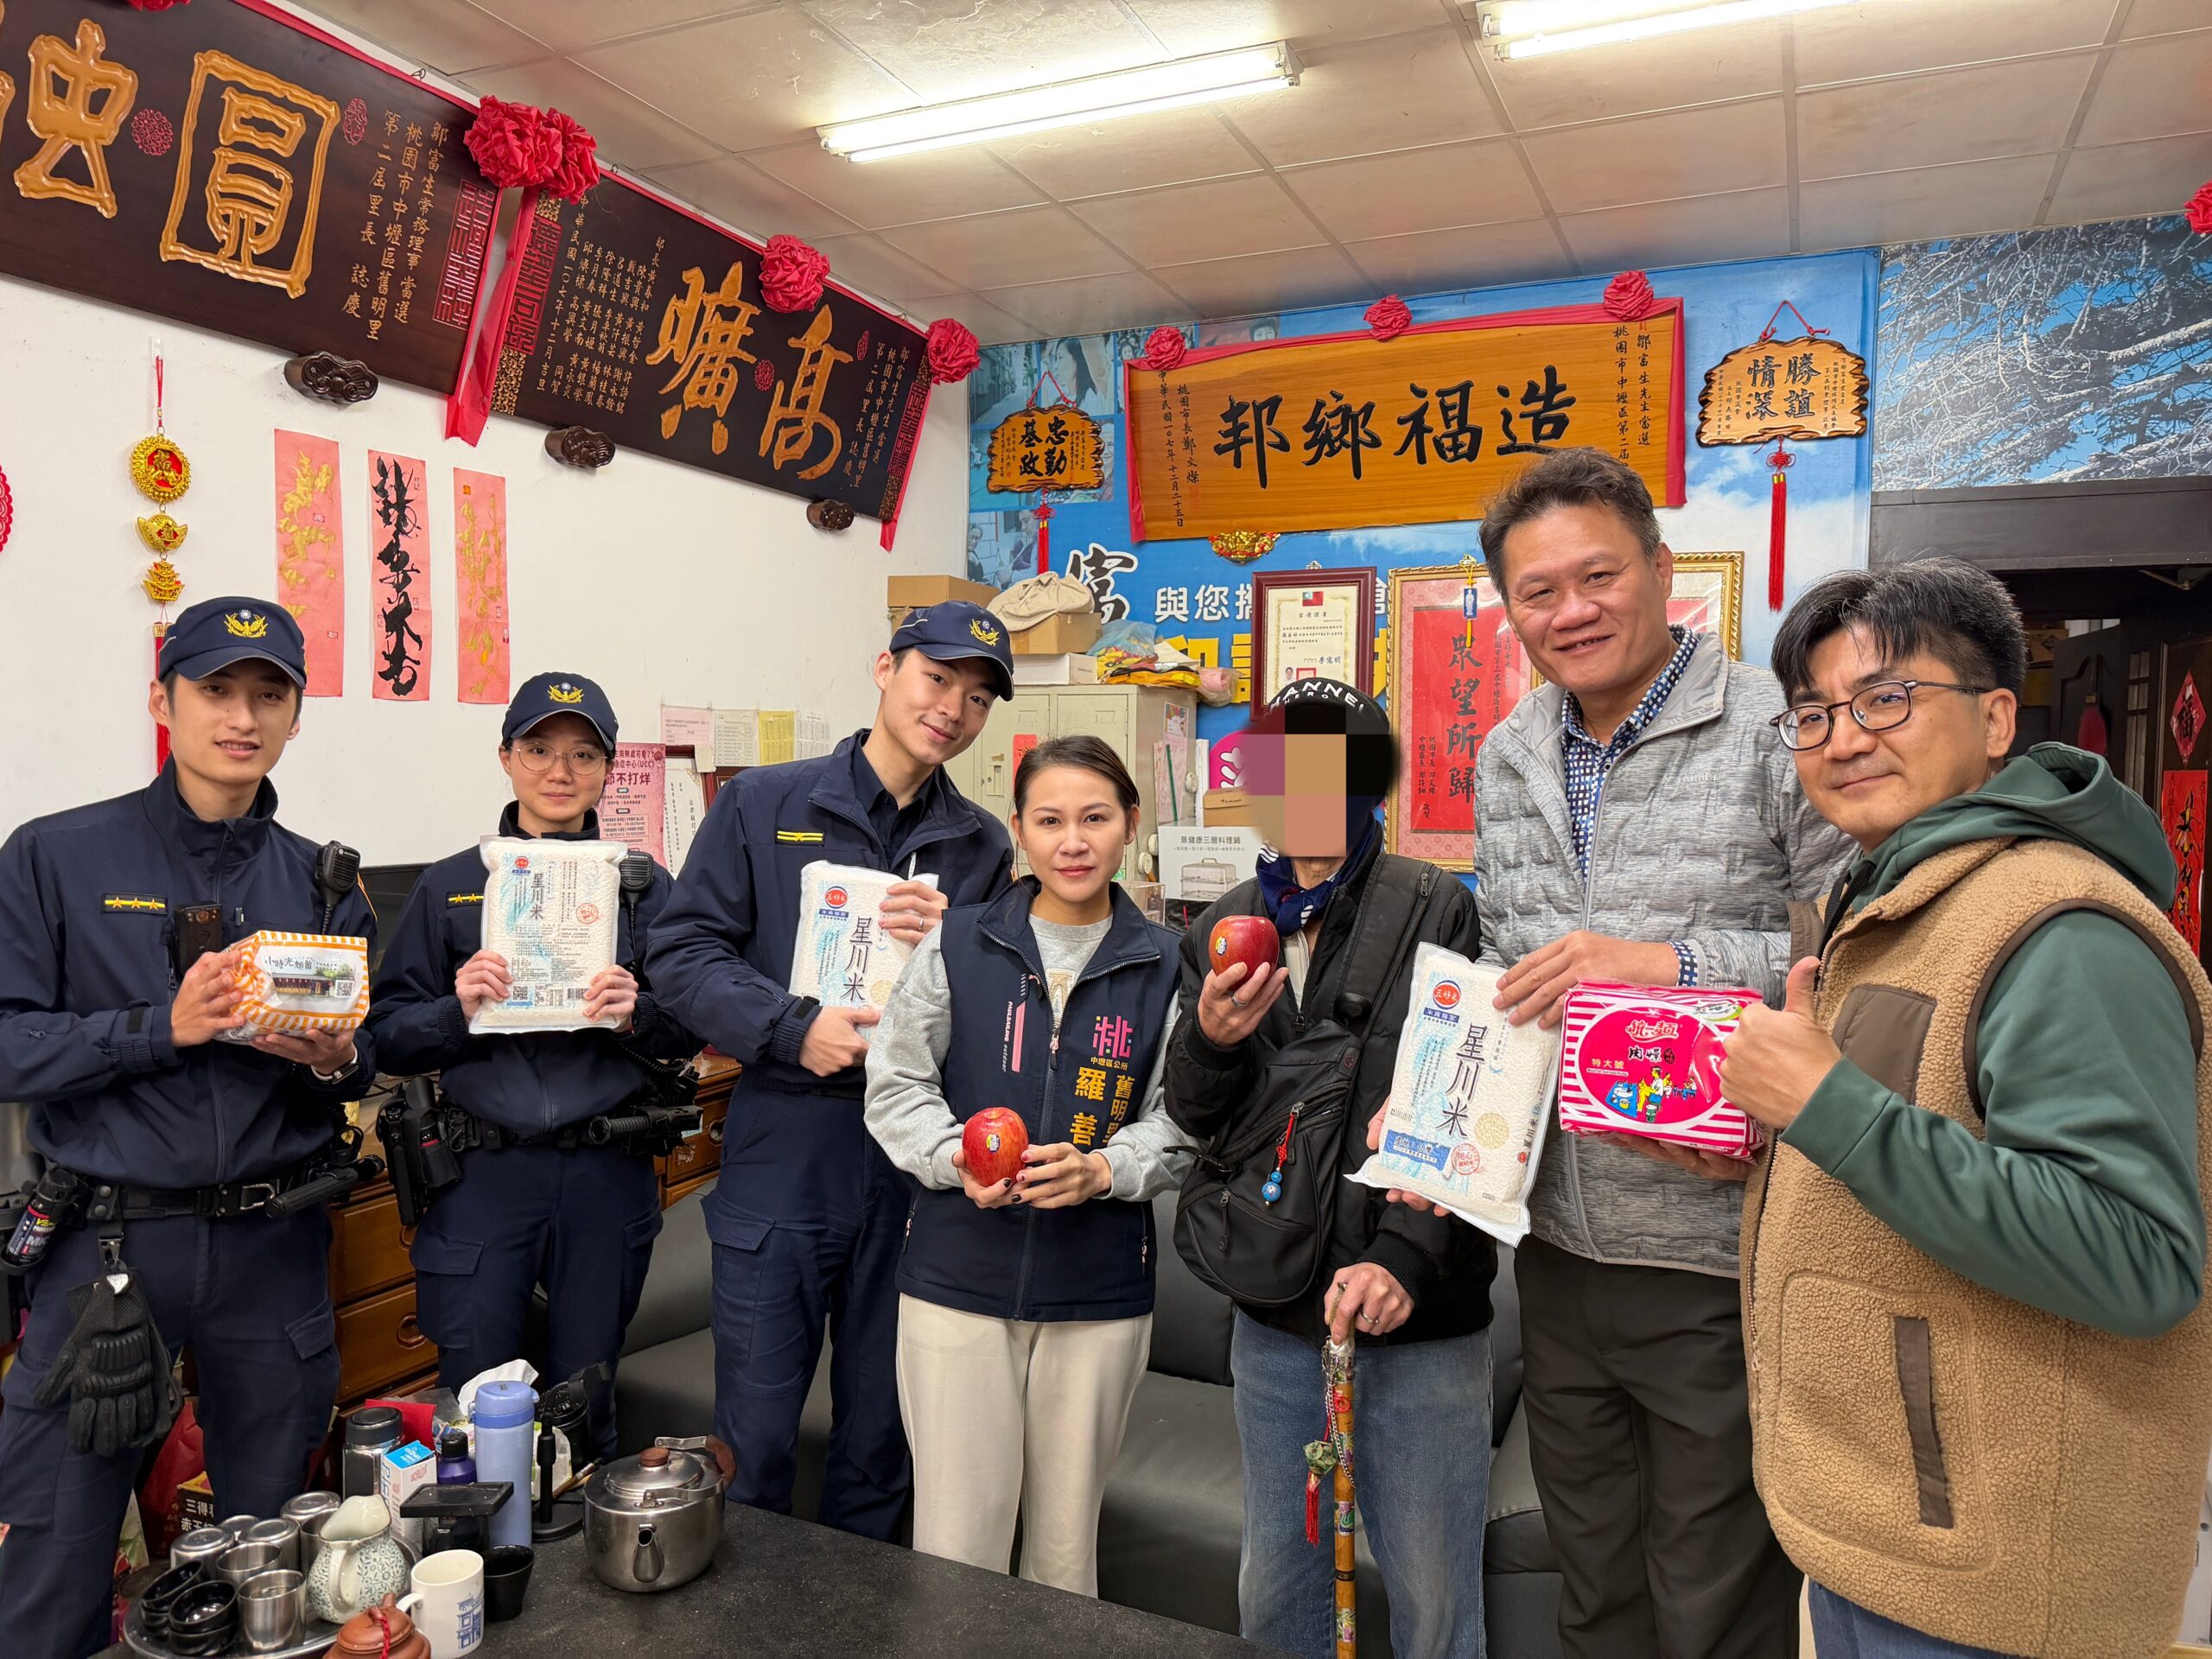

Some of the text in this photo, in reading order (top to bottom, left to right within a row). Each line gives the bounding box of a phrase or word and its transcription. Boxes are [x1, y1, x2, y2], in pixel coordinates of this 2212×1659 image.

[366, 122, 423, 340] 桃園市中壢區舊明里
[1213, 365, 1592, 490] 造福鄉邦
[1612, 324, 1630, 467] 桃園市中壢區第二屆
[840, 916, 873, 1002] 星川米
[1436, 1022, 1488, 1138] 星川米
